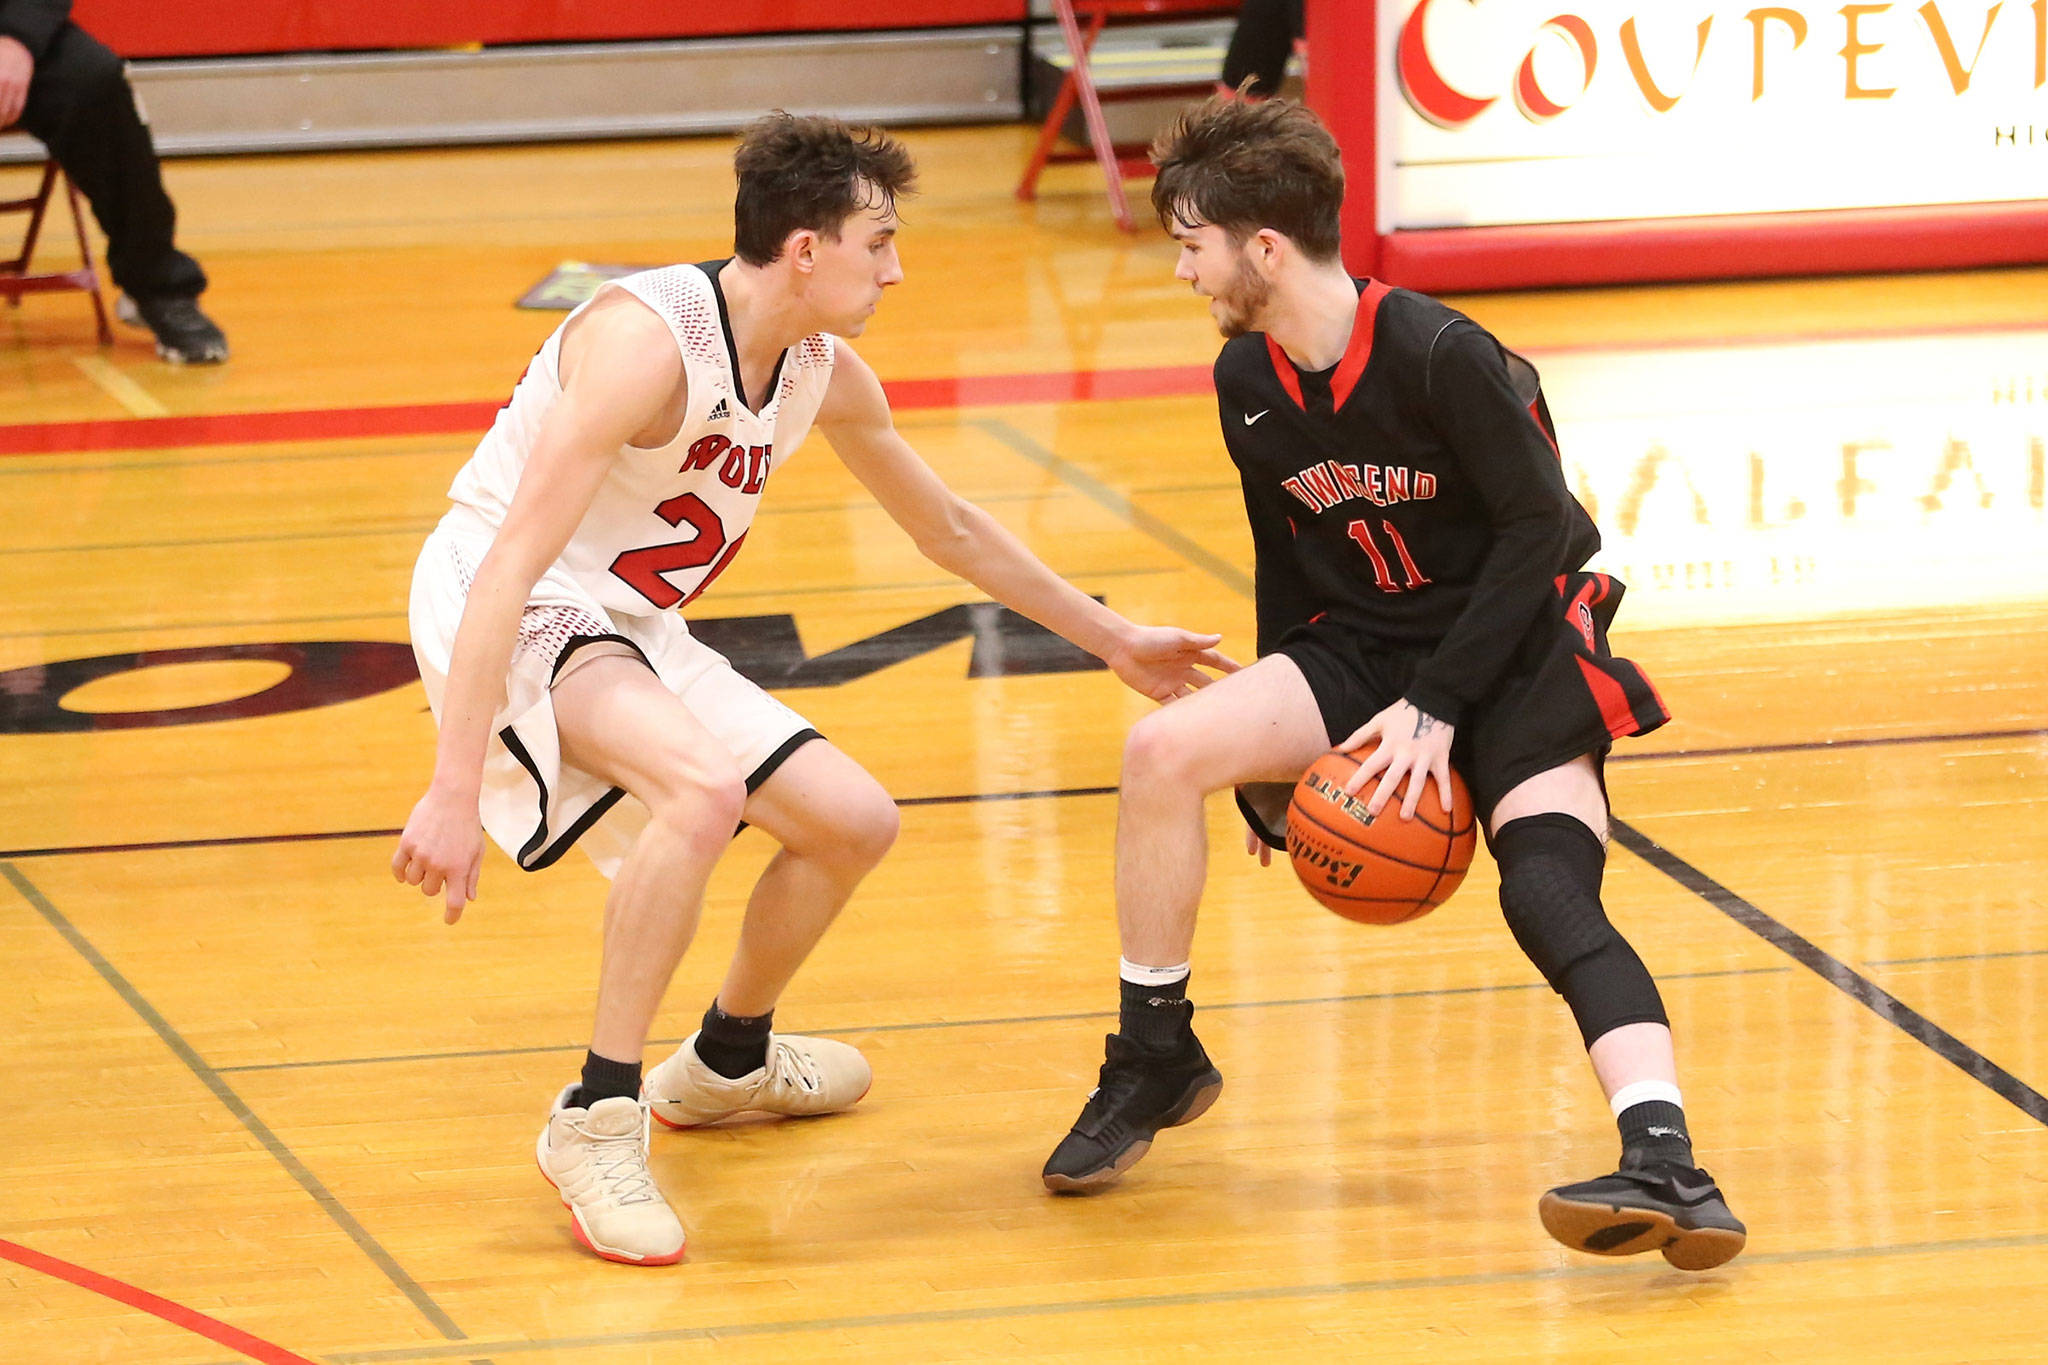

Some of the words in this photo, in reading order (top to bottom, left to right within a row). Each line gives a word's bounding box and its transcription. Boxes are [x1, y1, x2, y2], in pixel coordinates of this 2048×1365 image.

[1995, 124, 2048, 146] HI
[607, 491, 750, 610] 2
[1347, 518, 1434, 593] 11
[1305, 771, 1376, 828] ELITE
